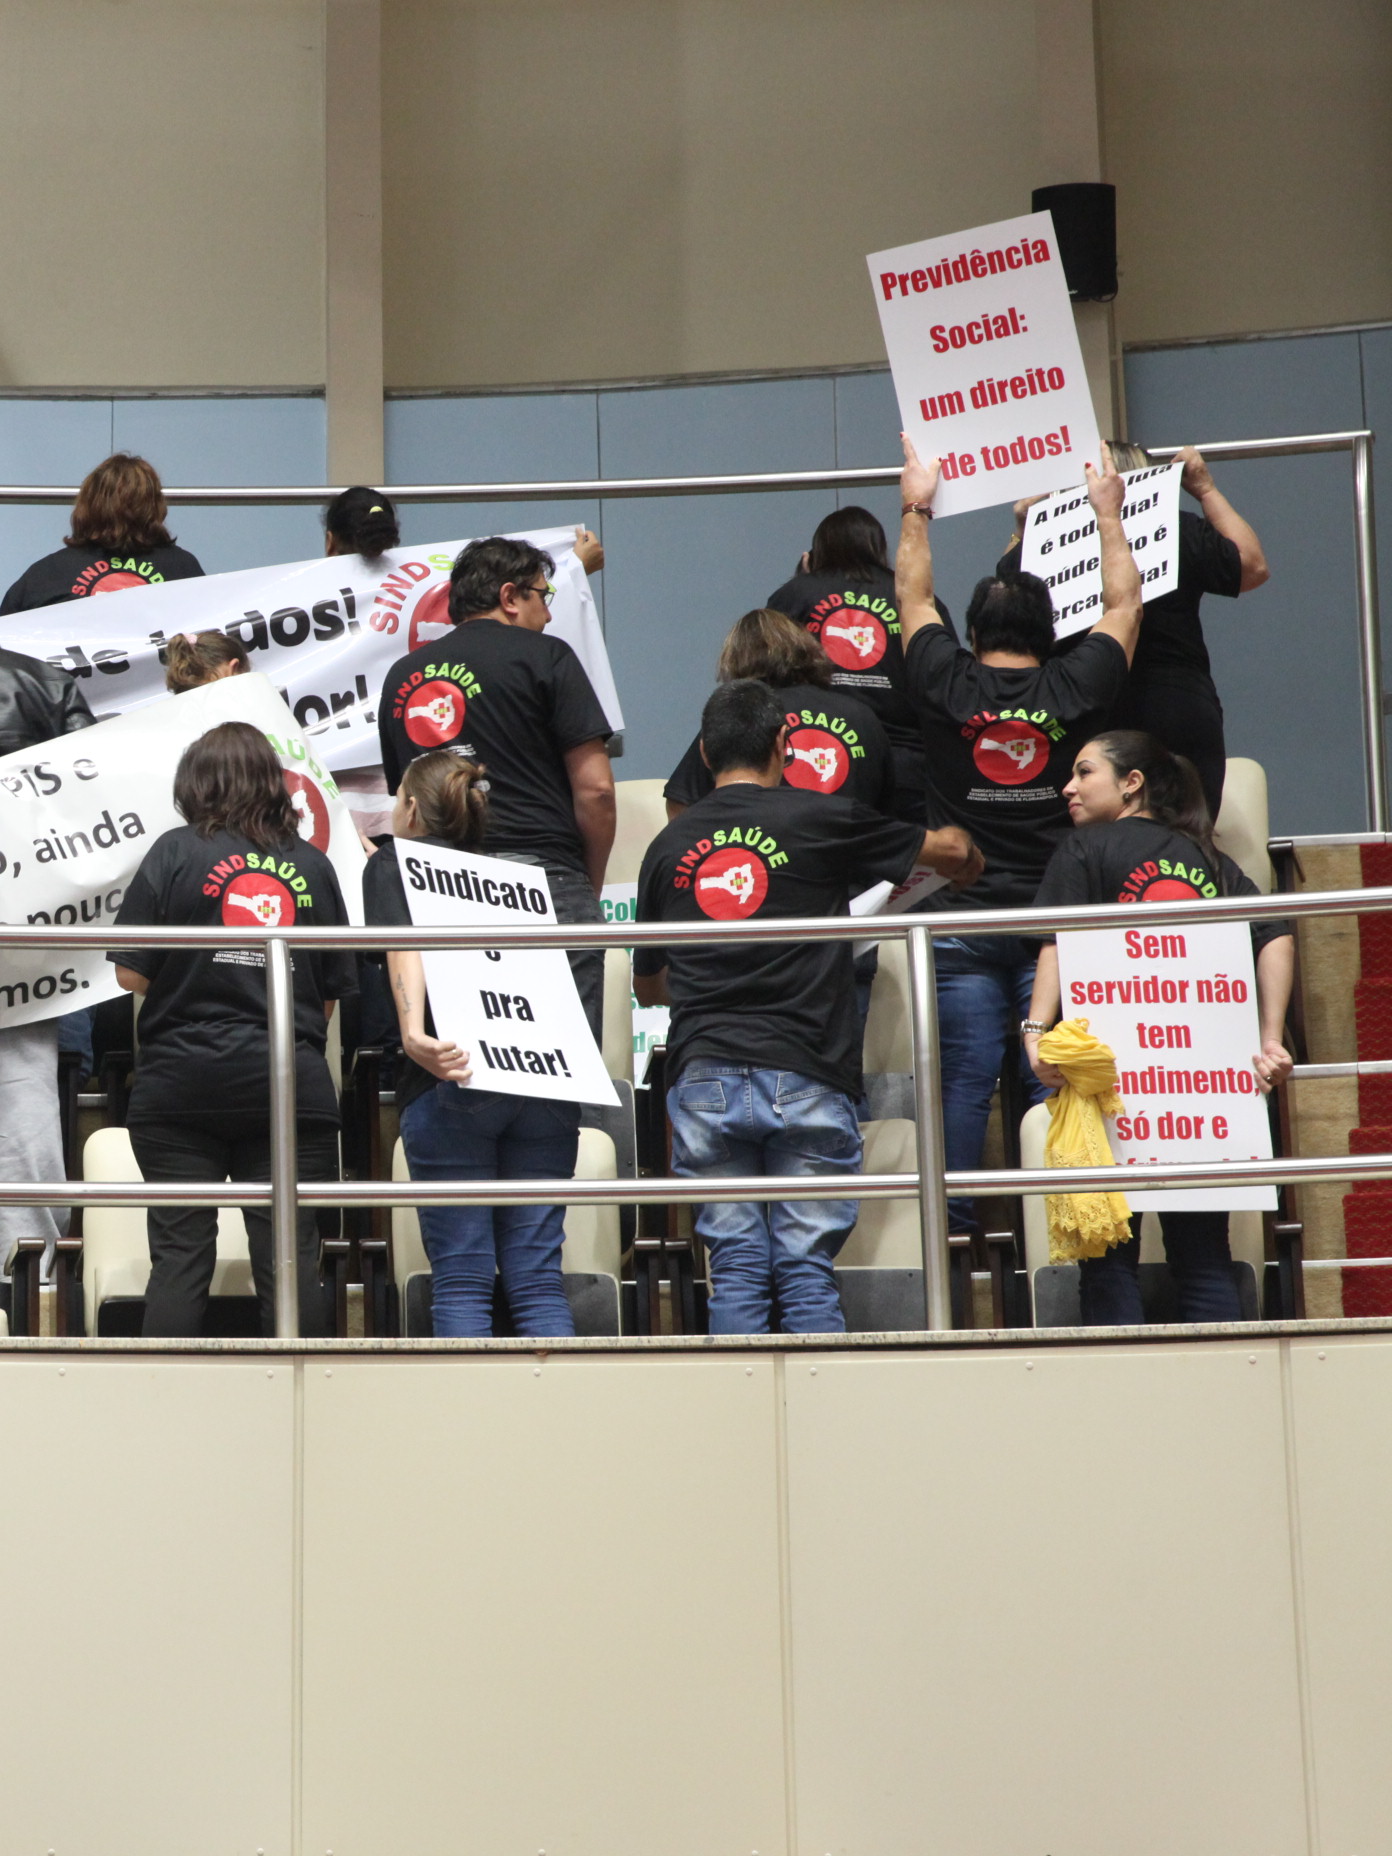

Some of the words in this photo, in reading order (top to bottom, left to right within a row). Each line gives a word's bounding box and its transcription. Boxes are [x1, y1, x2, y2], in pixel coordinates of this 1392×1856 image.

[880, 238, 1051, 300] Previdência
[930, 307, 1028, 353] Social:
[920, 390, 965, 421] um
[970, 366, 1065, 409] direito
[941, 452, 976, 481] de
[980, 425, 1072, 471] todos!
[1034, 510, 1047, 526] A
[1054, 494, 1089, 517] nos
[1041, 539, 1053, 555] é
[1060, 520, 1098, 547] tod
[1045, 556, 1099, 589] aúde
[1154, 524, 1167, 542] é
[72, 557, 165, 596] SINDSAÚD
[807, 591, 902, 634] SINDSAÚDE
[393, 662, 482, 719] SINDSAÚDE
[786, 710, 865, 758] DSAÚDE
[32, 810, 146, 863] ainda
[674, 826, 789, 889] SINDSAÚDE
[202, 853, 313, 908] SINDSAÚDE
[405, 857, 548, 915] Sindicato
[1118, 859, 1218, 903] SINDSAÚD
[1125, 930, 1187, 959] Sem
[479, 990, 535, 1022] pra
[1070, 975, 1189, 1005] servidor
[1196, 973, 1248, 1003] não
[1136, 1022, 1192, 1049] tem
[478, 1040, 572, 1078] lutar!
[1113, 1066, 1260, 1097] ndimento,
[1116, 1111, 1150, 1141] só
[1157, 1111, 1205, 1140] dor
[1212, 1114, 1228, 1139] e
